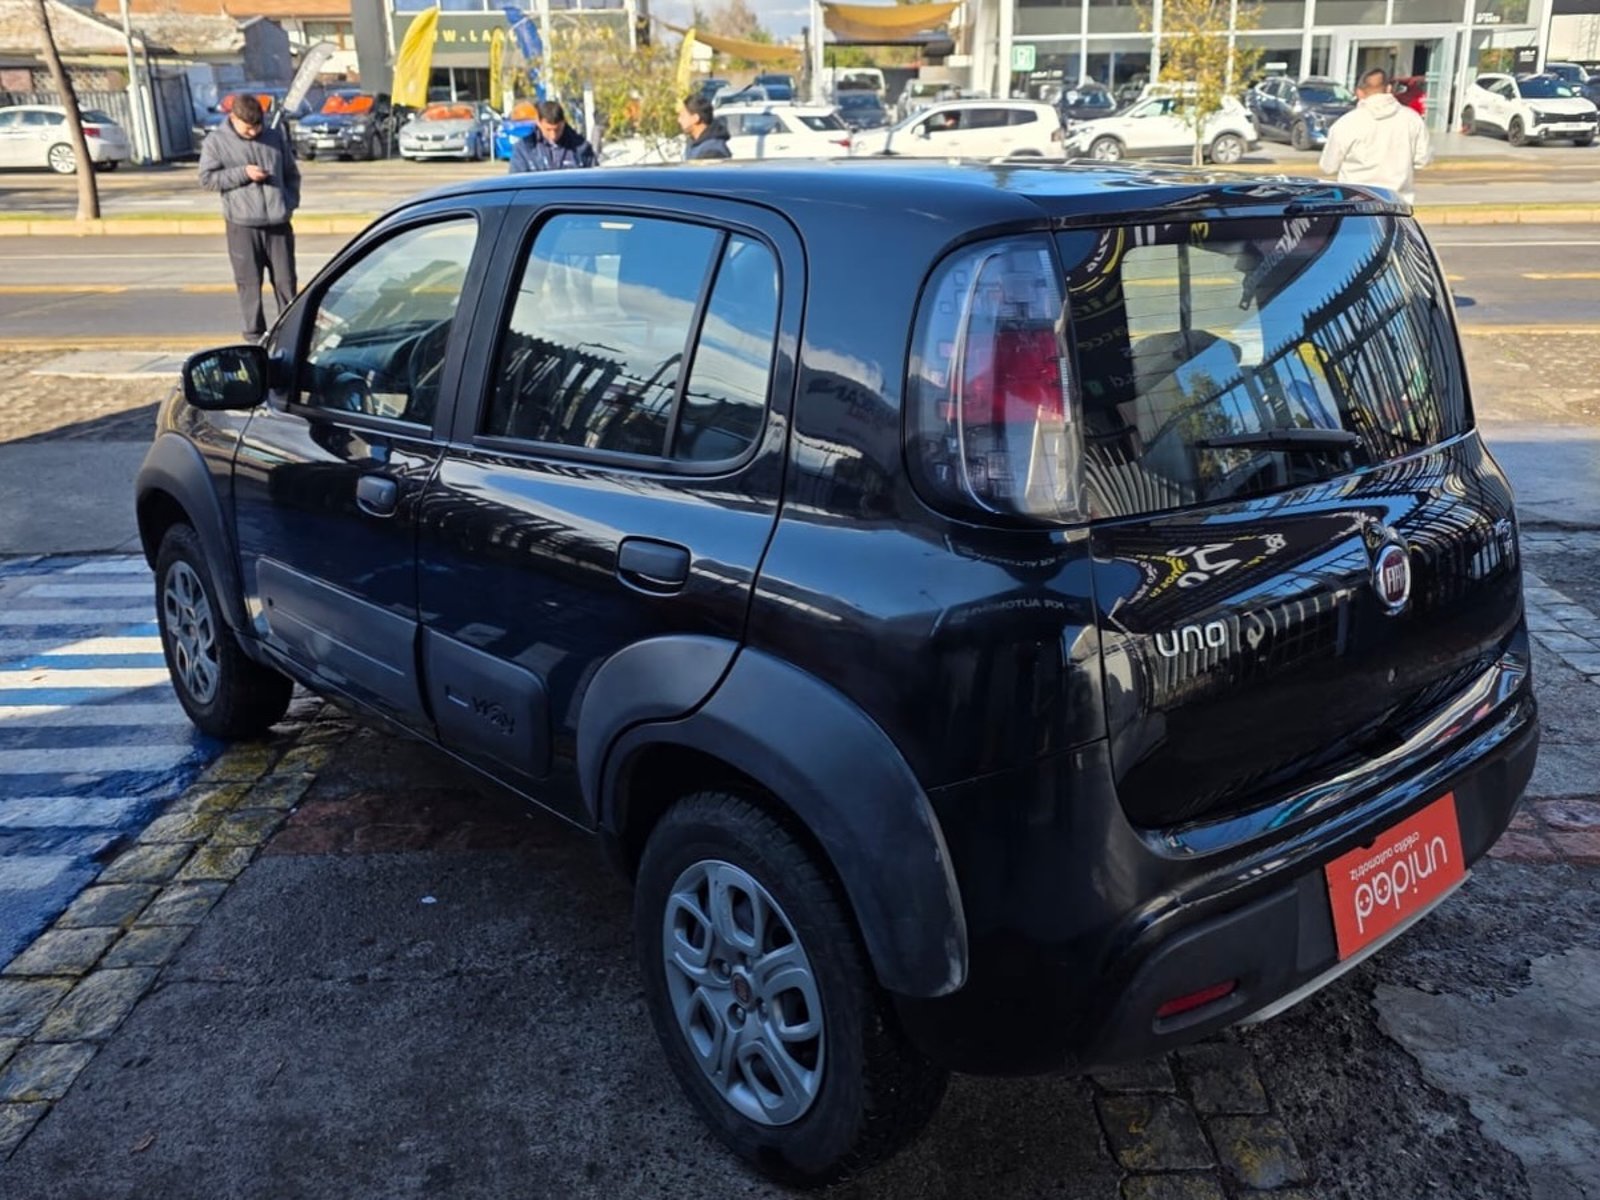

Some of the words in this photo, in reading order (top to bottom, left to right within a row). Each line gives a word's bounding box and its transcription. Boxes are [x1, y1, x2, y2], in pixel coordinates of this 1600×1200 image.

[1386, 563, 1406, 594] FIAT
[1156, 621, 1225, 657] uno
[1393, 831, 1420, 853] crédito
[1349, 847, 1393, 881] automotriz
[1354, 836, 1448, 934] unidad
